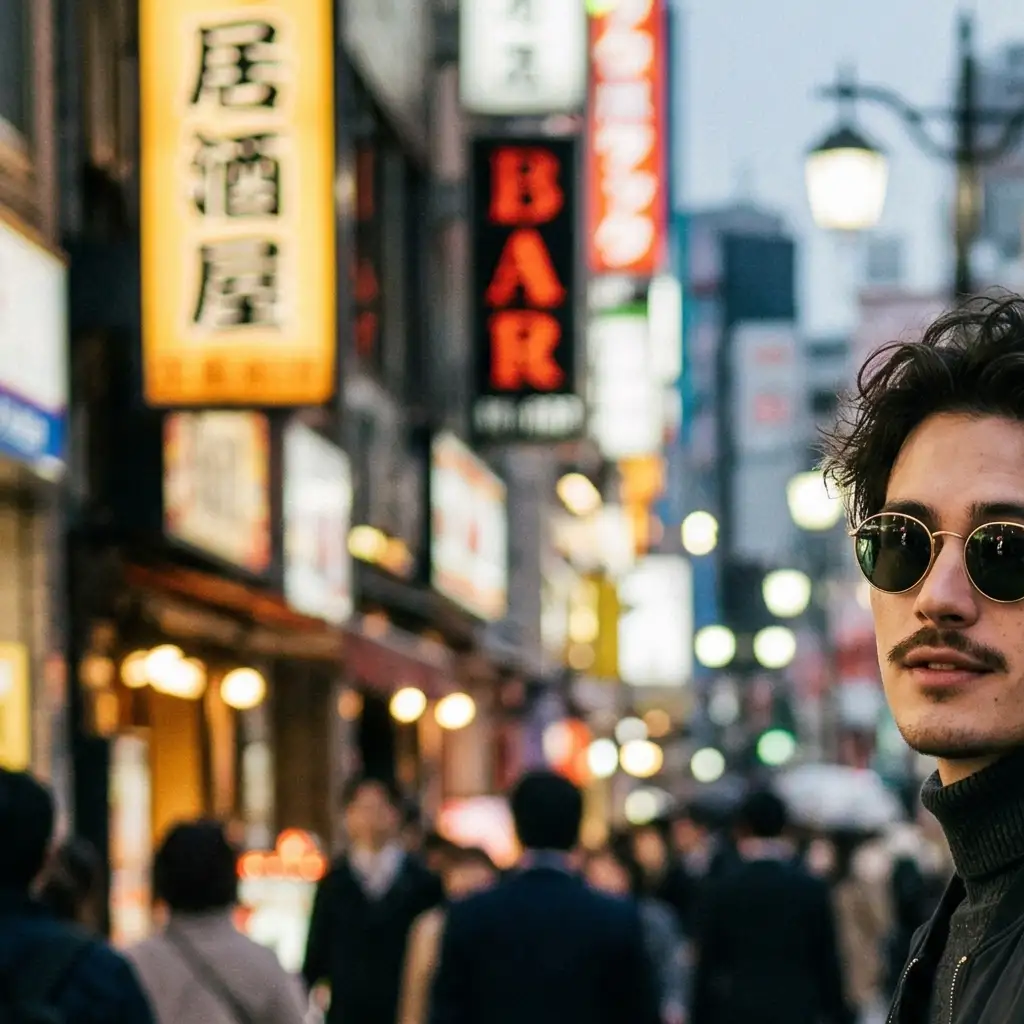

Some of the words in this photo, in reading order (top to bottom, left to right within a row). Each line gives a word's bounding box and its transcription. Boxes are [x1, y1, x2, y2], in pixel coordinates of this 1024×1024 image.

[191, 21, 281, 330] 居酒屋
[487, 146, 566, 390] BAR
